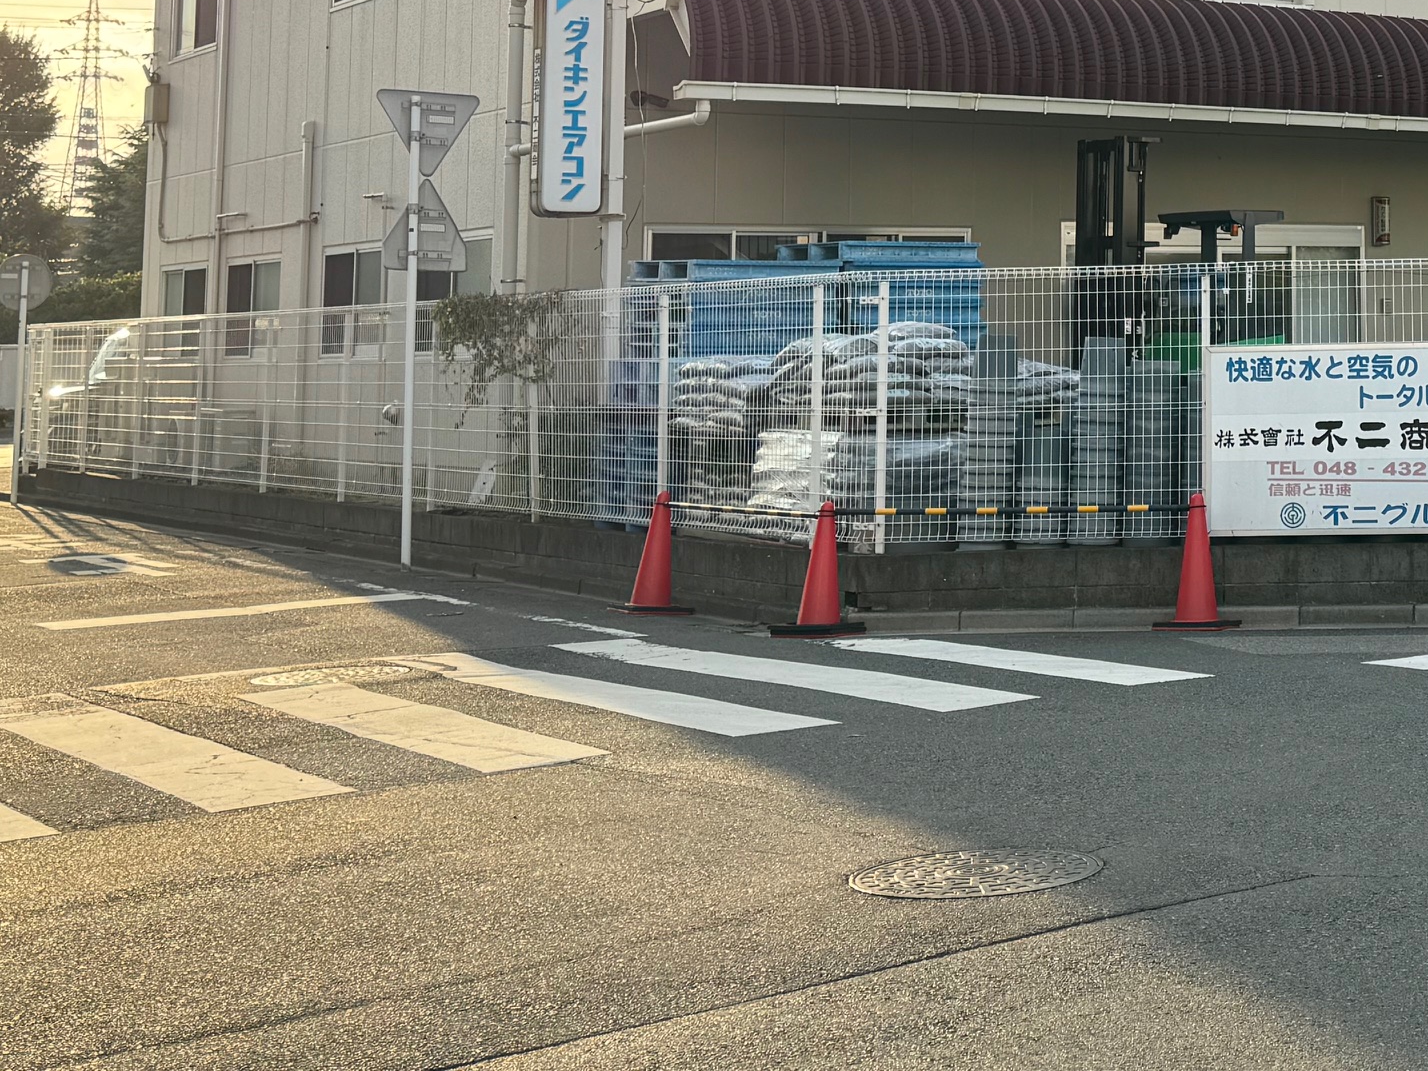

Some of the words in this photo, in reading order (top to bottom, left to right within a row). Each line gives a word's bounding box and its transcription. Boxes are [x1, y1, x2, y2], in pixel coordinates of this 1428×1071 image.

[560, 16, 590, 201] ダイキンエアコン
[1226, 353, 1419, 383] 快適な水と空気の
[1266, 461, 1305, 476] TEL
[1268, 482, 1352, 497] 信頼と迅速
